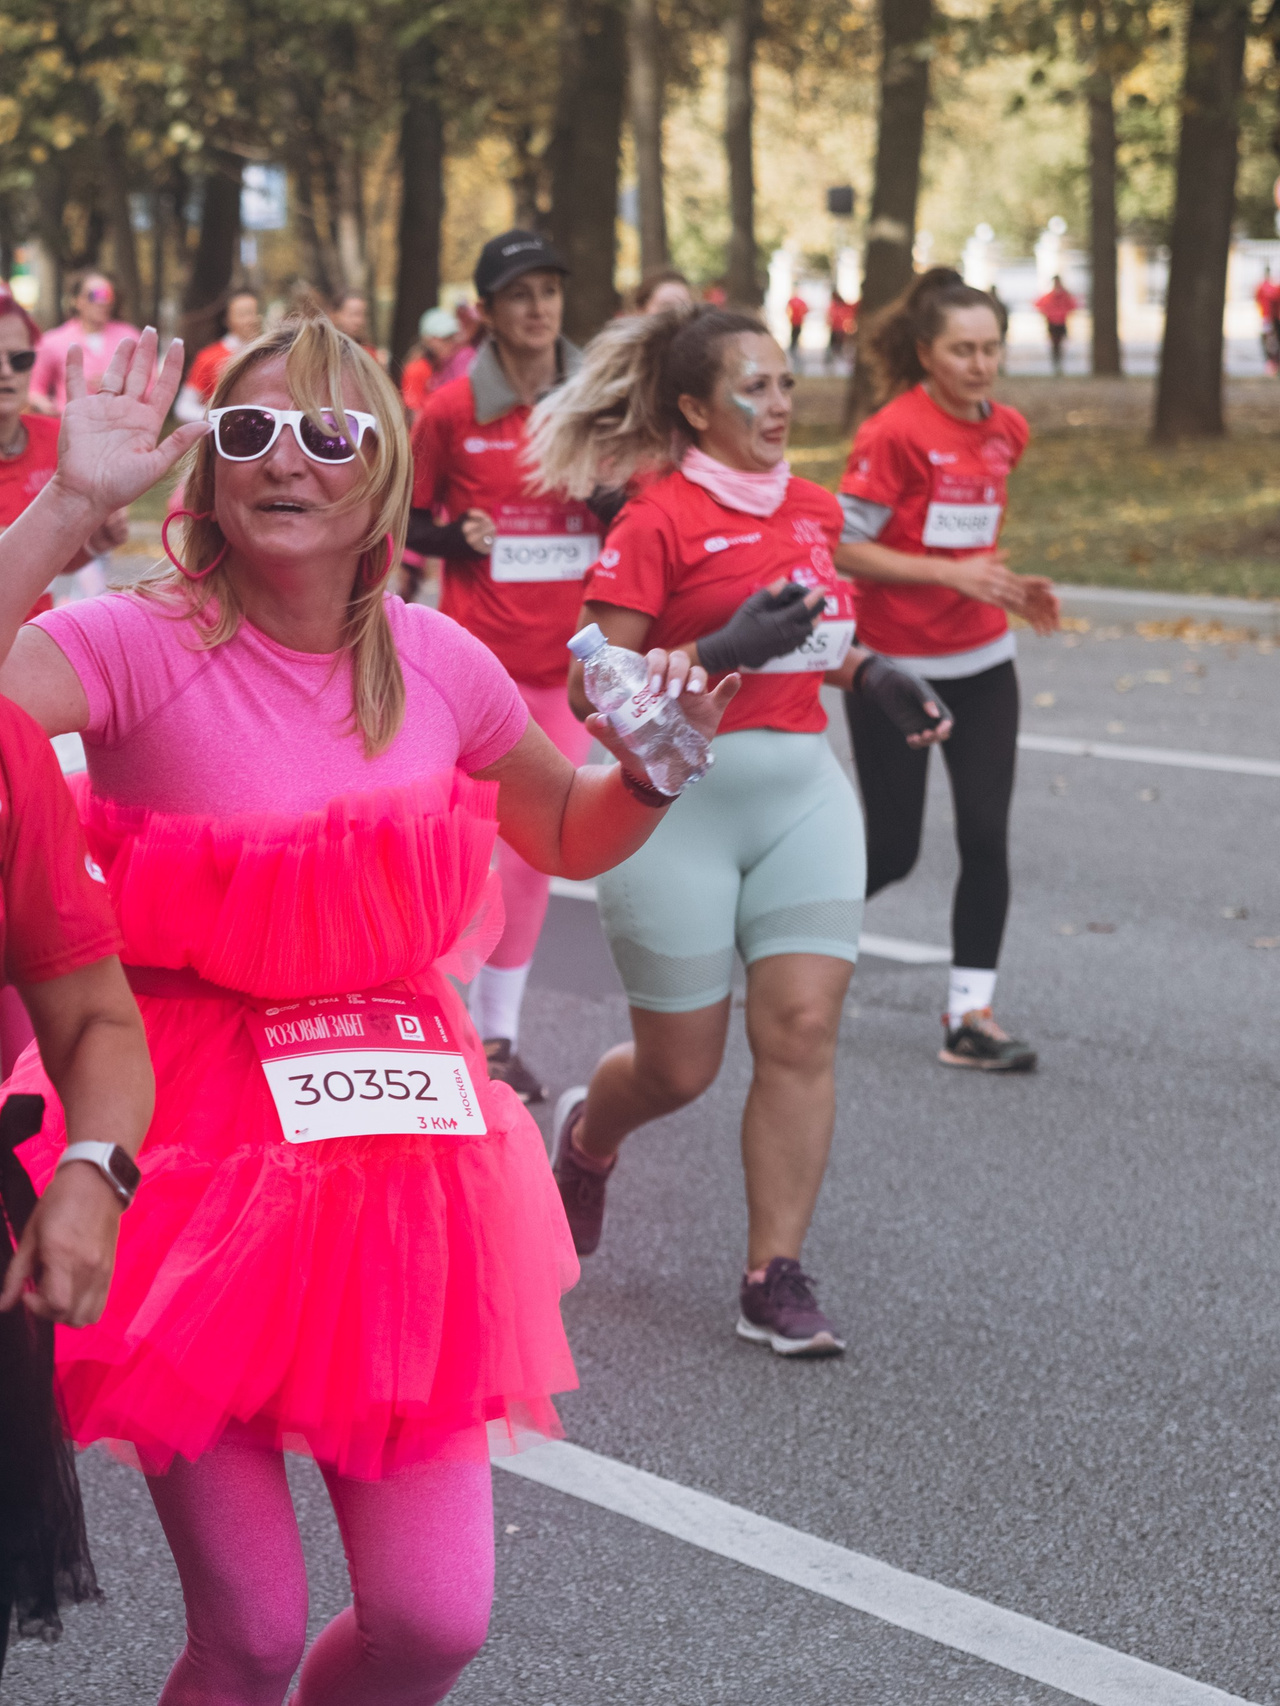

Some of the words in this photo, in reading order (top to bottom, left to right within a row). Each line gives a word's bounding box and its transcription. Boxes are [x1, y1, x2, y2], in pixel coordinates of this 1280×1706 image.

[264, 1013, 331, 1047] РОЗОВЫЙ
[328, 1013, 365, 1037] ЗАБЕГ
[400, 1017, 418, 1034] D
[288, 1069, 438, 1106] 30352
[453, 1068, 473, 1117] МОСКВА
[417, 1116, 427, 1129] 3
